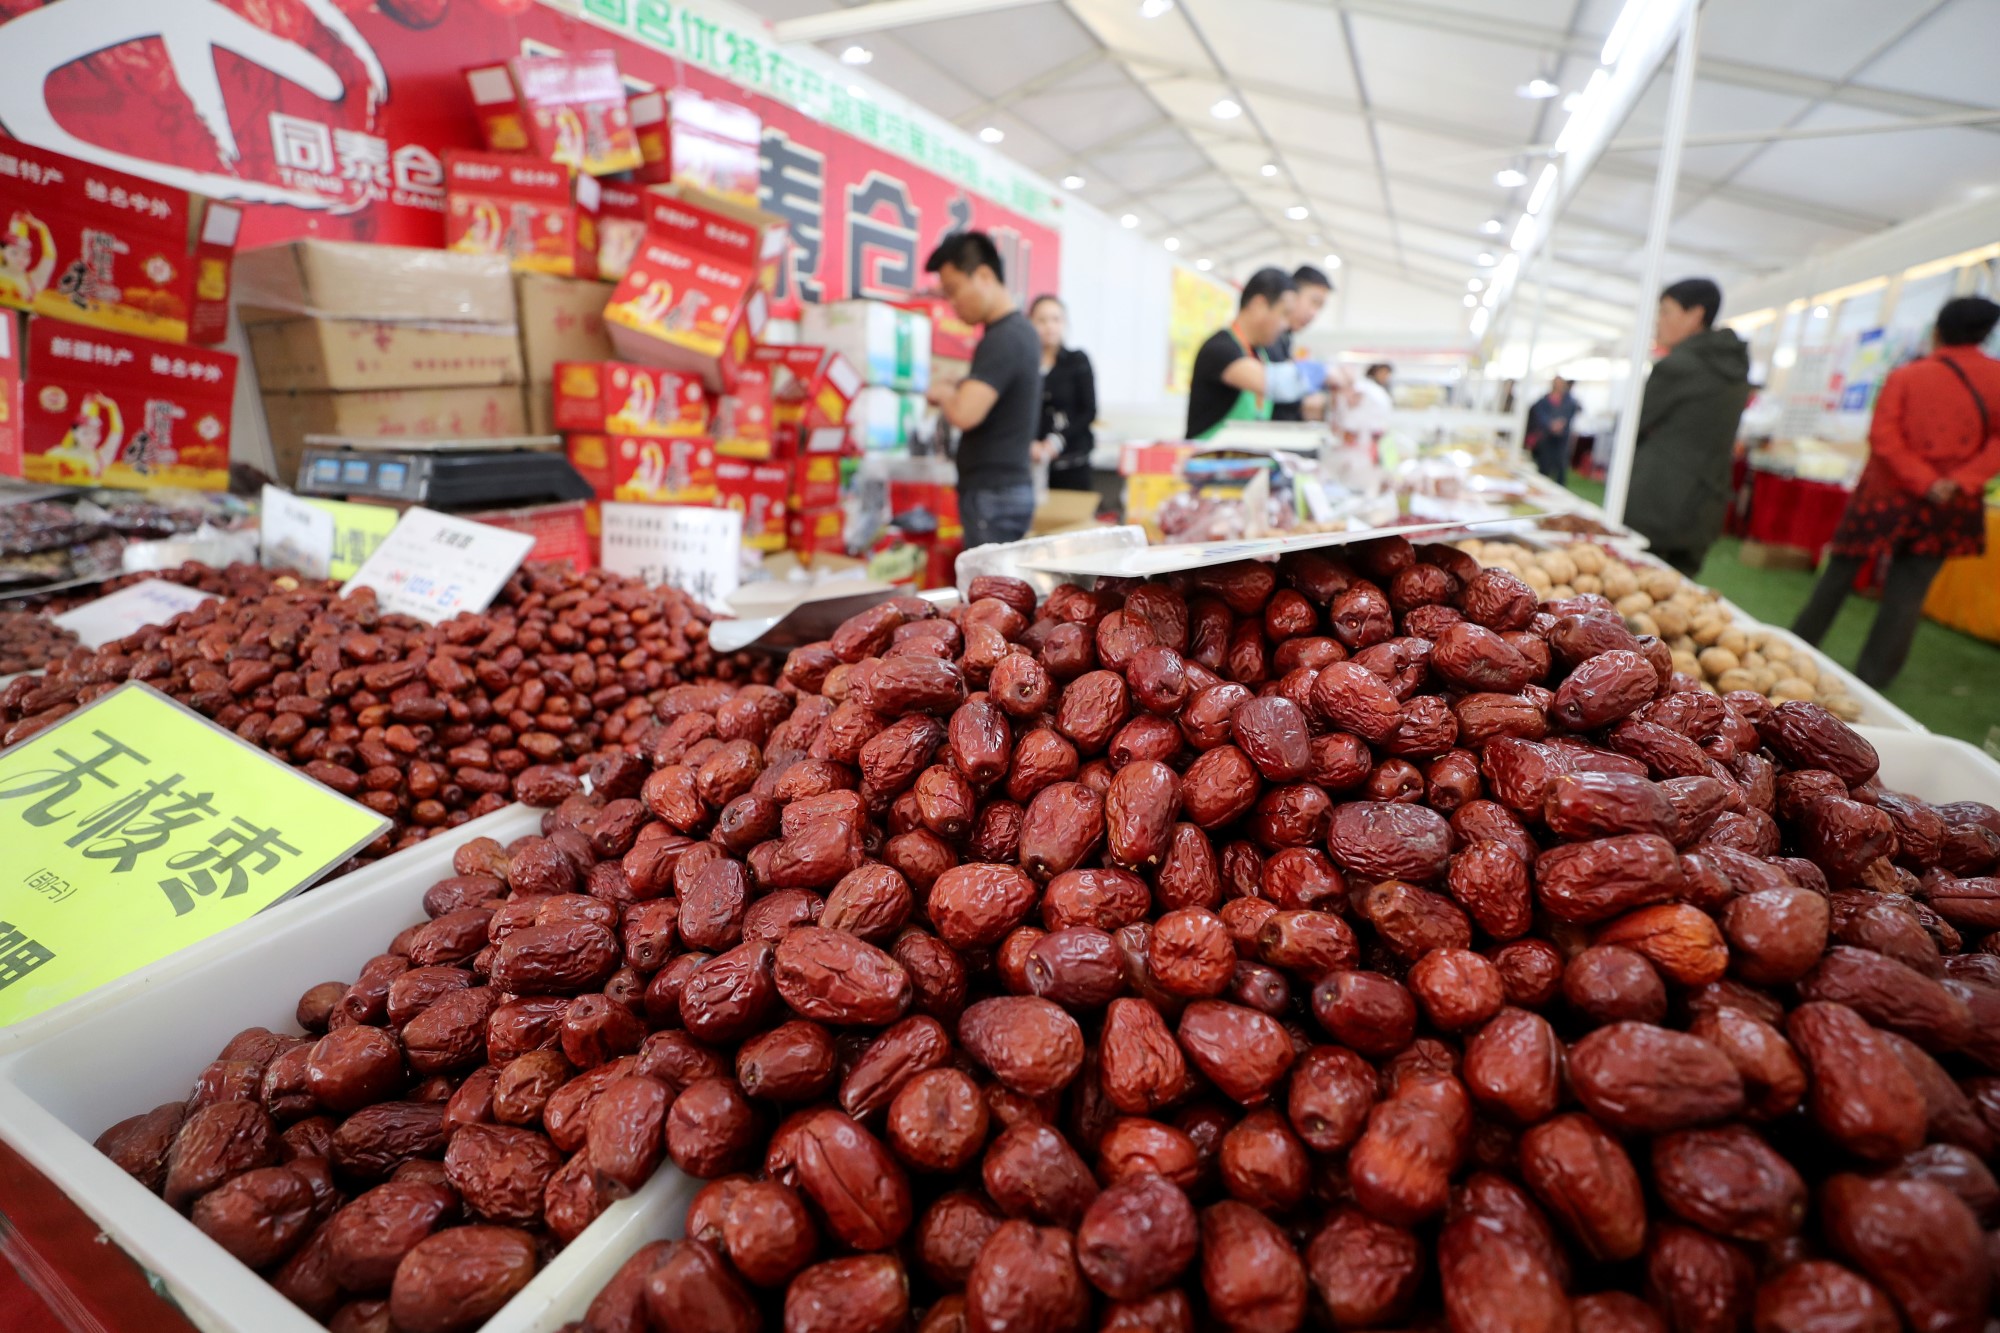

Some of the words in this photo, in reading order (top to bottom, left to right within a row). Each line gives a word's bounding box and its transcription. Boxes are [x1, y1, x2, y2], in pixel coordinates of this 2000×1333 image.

[269, 111, 446, 199] 同泰仓
[51, 336, 134, 367] 新疆特产
[151, 353, 223, 383] 驰名中外
[0, 729, 304, 917] 无核枣
